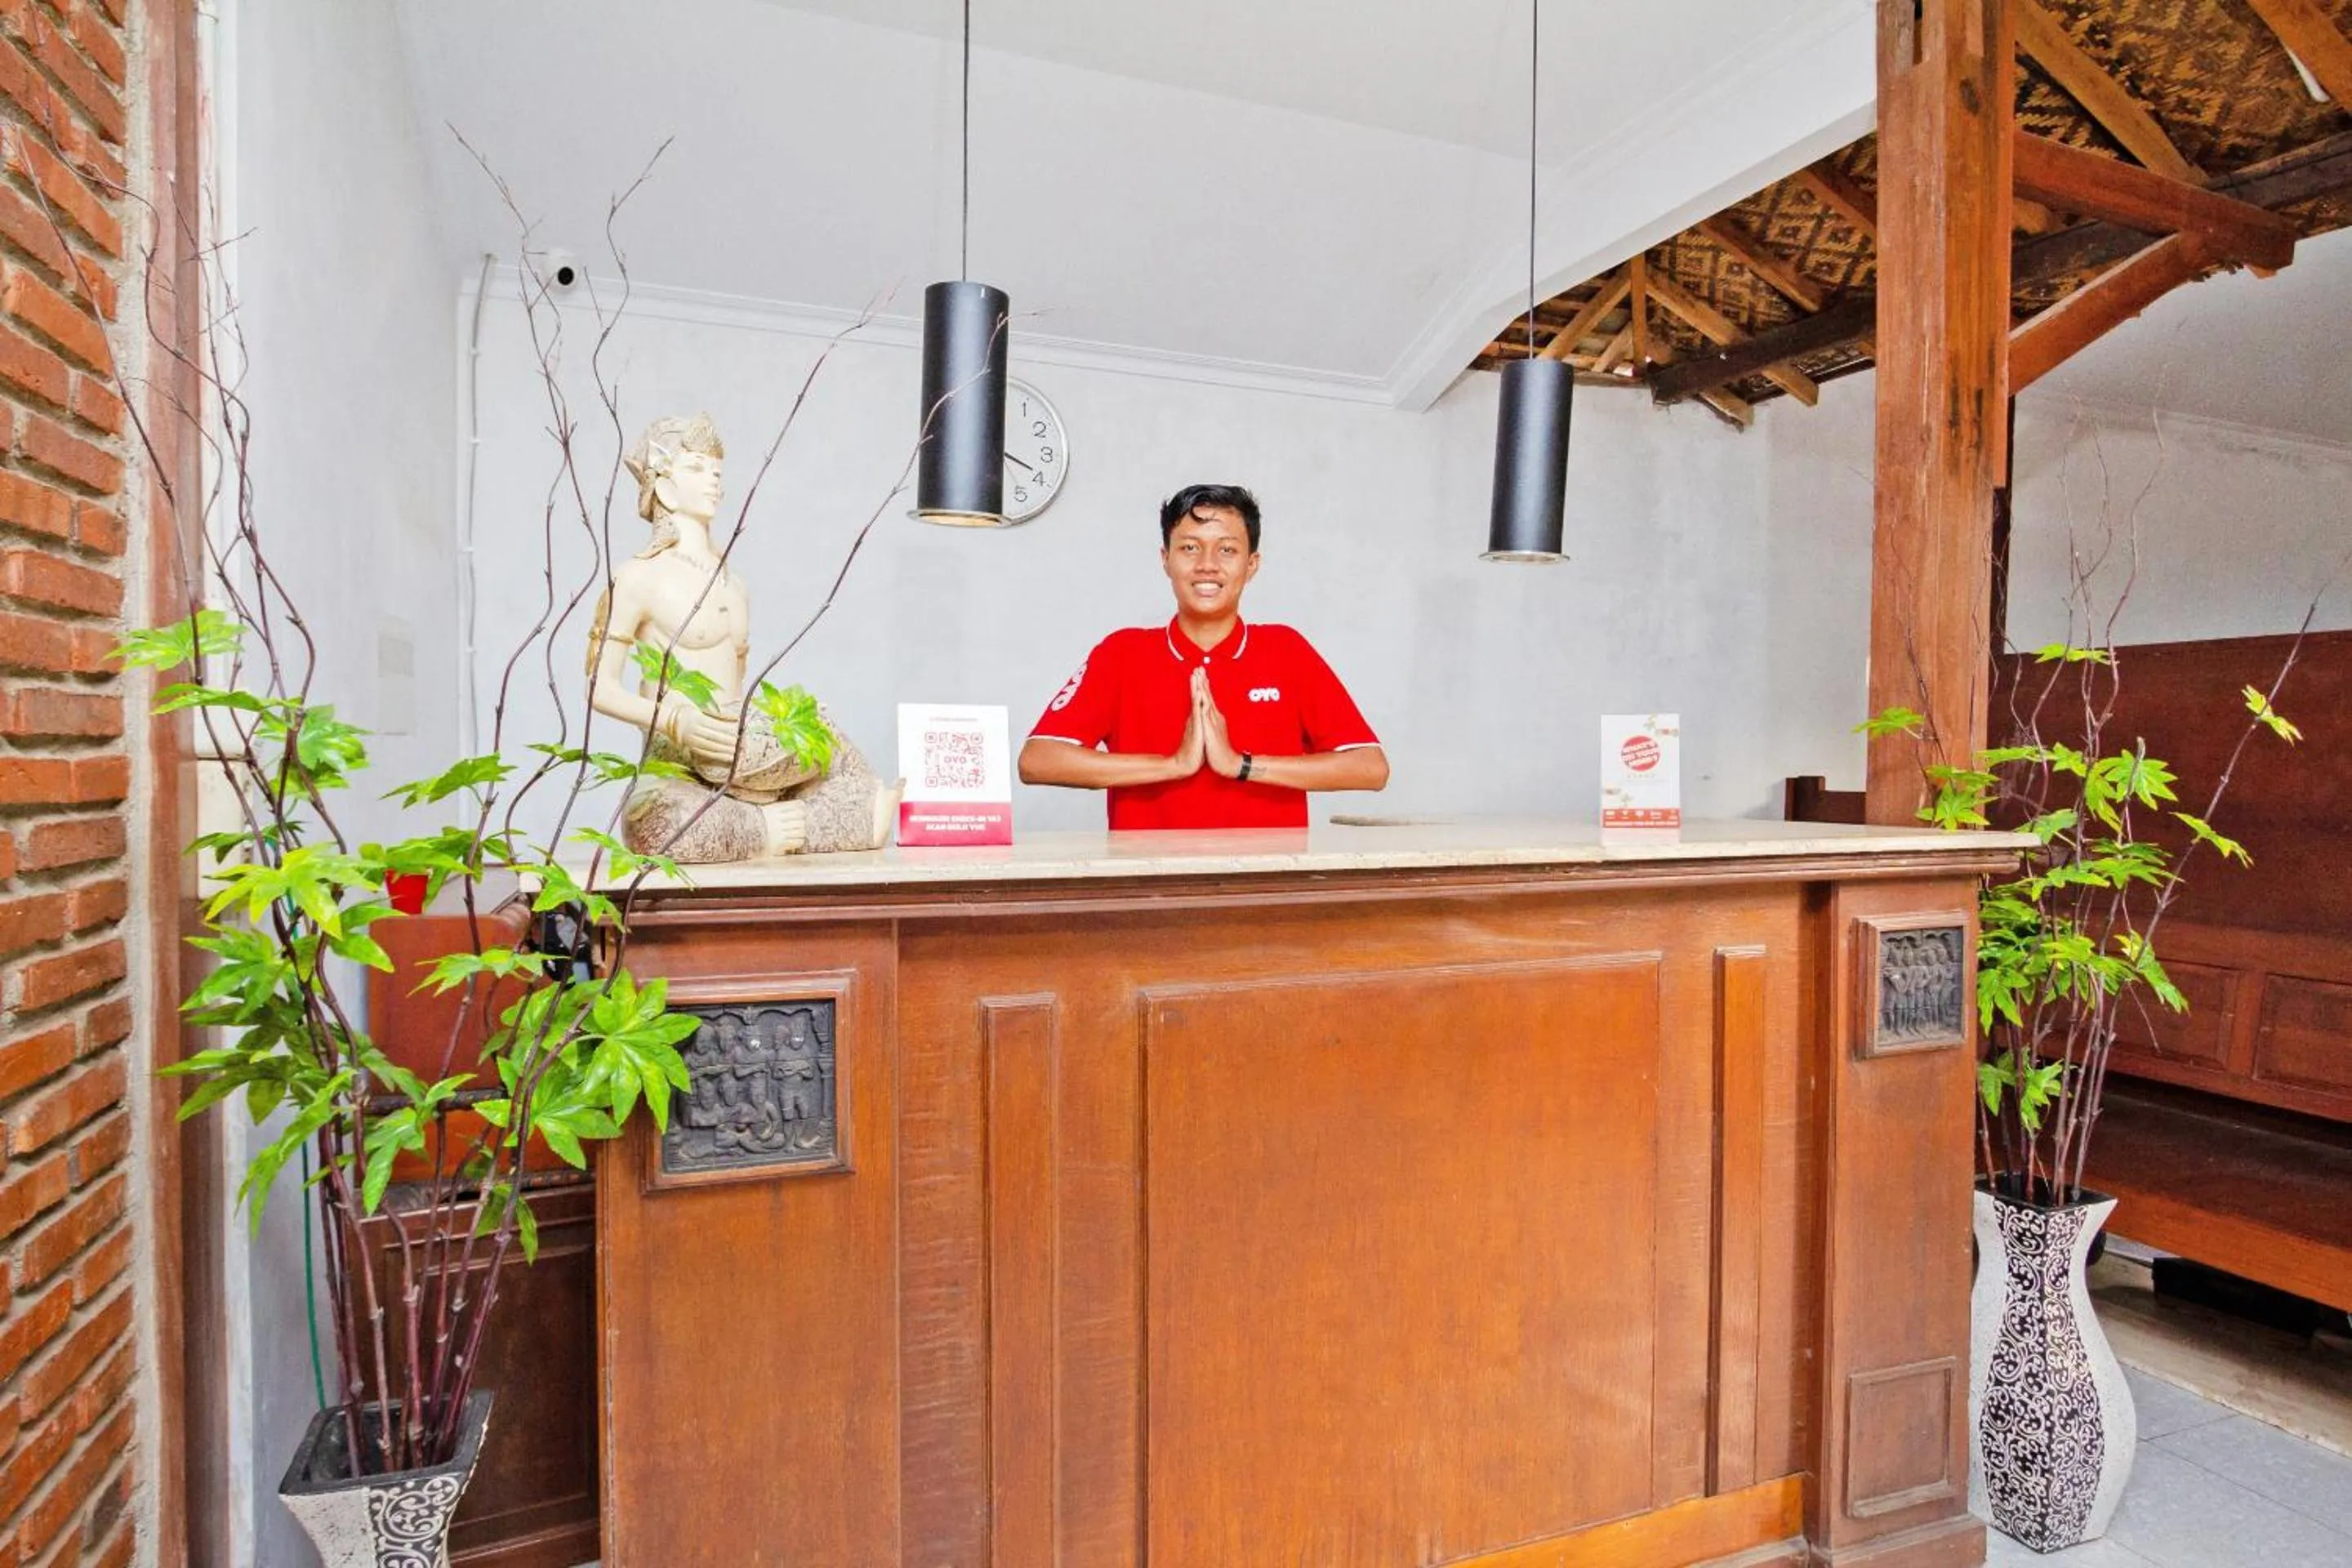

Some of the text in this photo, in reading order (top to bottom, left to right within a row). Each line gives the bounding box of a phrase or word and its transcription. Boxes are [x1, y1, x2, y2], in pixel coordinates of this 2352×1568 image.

[1022, 401, 1027, 417] 1
[1032, 421, 1047, 439] 2
[1040, 446, 1054, 463] 3
[1031, 470, 1045, 487] 4
[1013, 486, 1028, 503] 5
